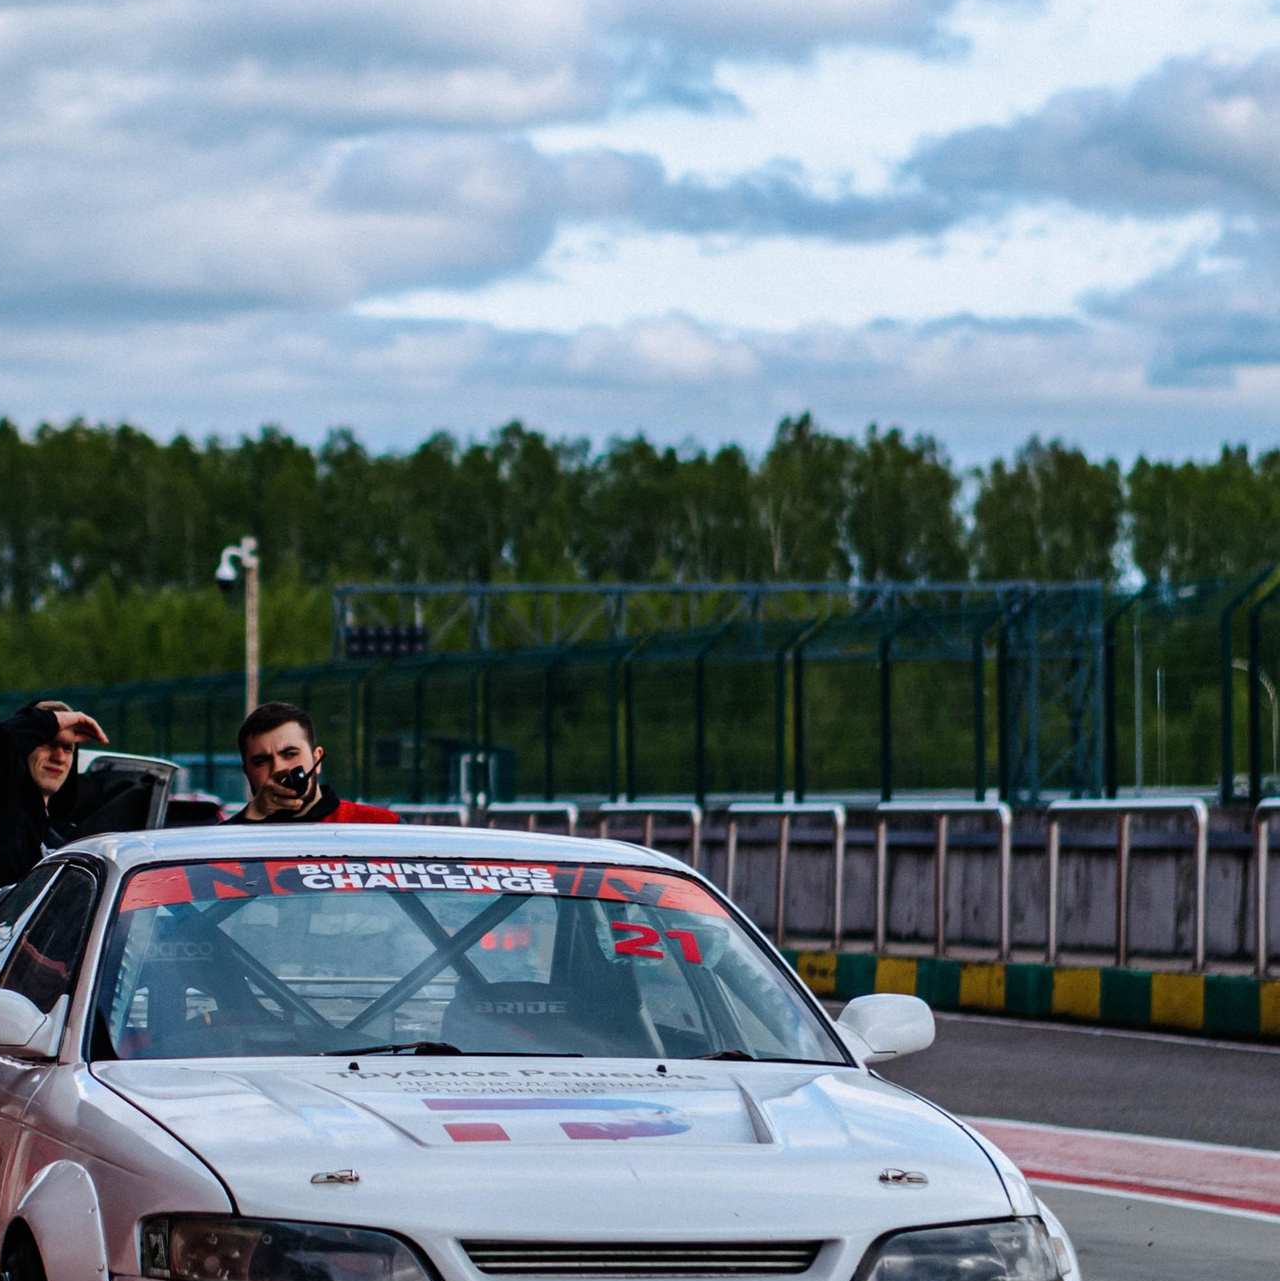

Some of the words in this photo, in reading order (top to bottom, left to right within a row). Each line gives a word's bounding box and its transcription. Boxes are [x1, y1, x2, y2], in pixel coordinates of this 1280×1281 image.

[296, 863, 450, 876] BURNING
[455, 865, 552, 879] TIRES
[302, 873, 558, 893] CHALLENGE
[610, 921, 703, 965] 21
[476, 1001, 568, 1015] BRIDE
[325, 1069, 511, 1080] Трубное
[518, 1070, 708, 1081] Решение
